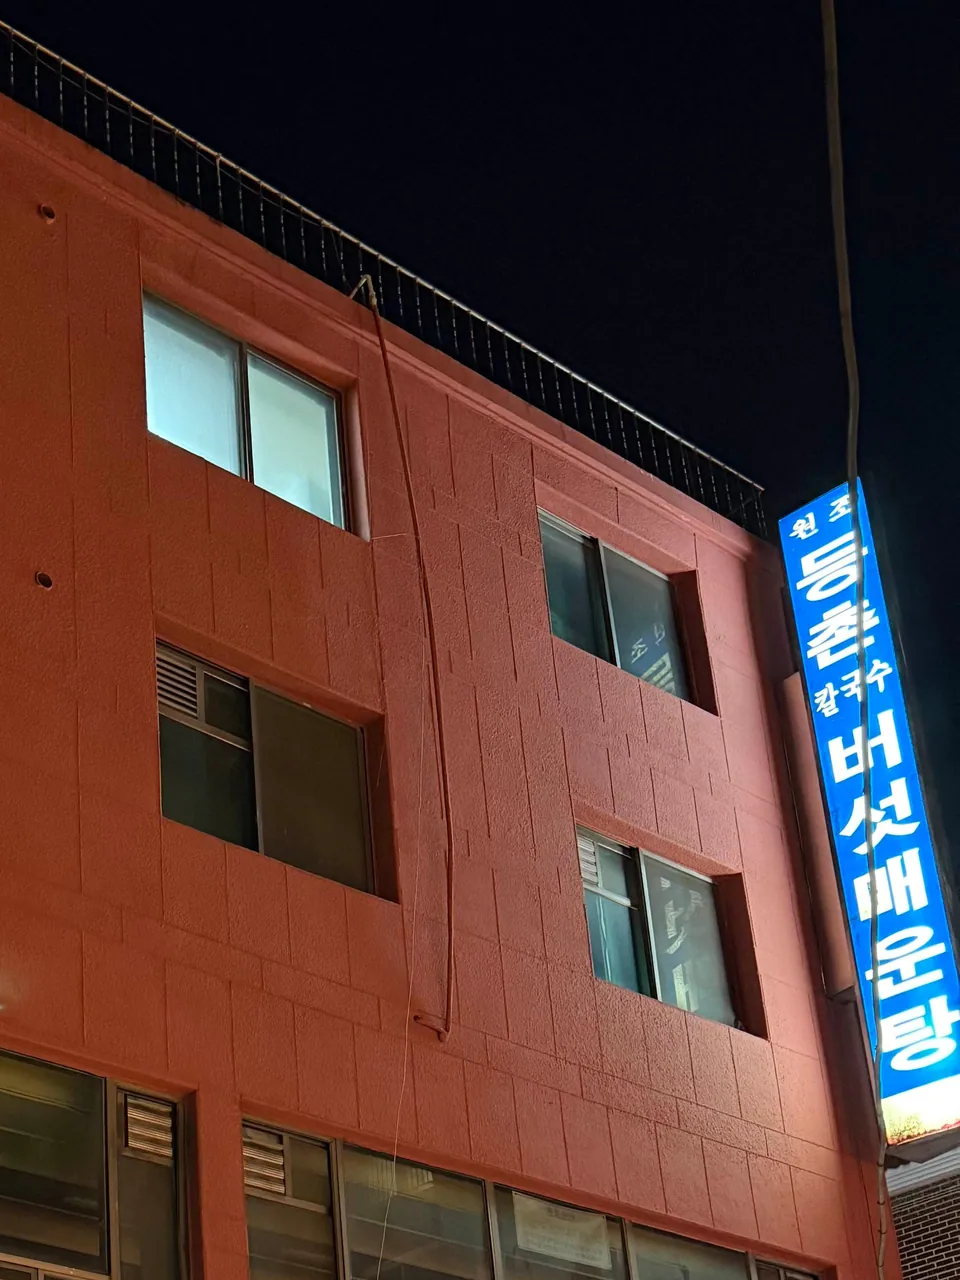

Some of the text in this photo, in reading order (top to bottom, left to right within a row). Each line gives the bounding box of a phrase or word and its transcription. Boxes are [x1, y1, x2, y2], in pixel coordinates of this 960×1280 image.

[789, 493, 853, 540] 원조
[796, 531, 880, 671] 등촌
[814, 658, 893, 718] 칼국수
[828, 708, 960, 1071] 버섯매운탕
